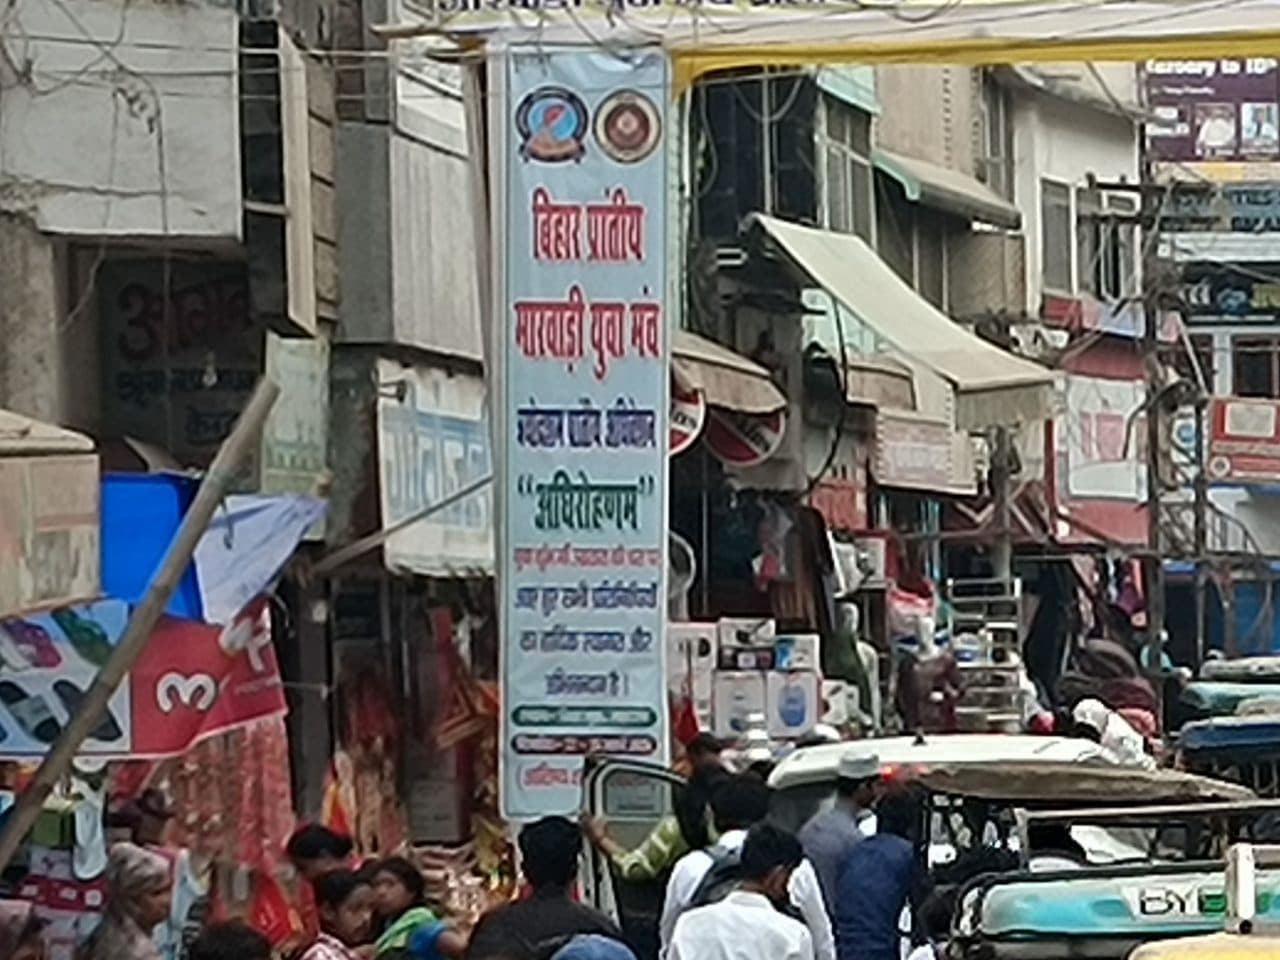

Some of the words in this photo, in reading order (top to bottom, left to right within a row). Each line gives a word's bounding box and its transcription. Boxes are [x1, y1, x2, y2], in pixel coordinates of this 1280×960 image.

[532, 187, 580, 260] बिहार
[587, 187, 643, 260] प्रांतीय
[590, 303, 625, 380] युवा
[630, 285, 660, 358] मंच
